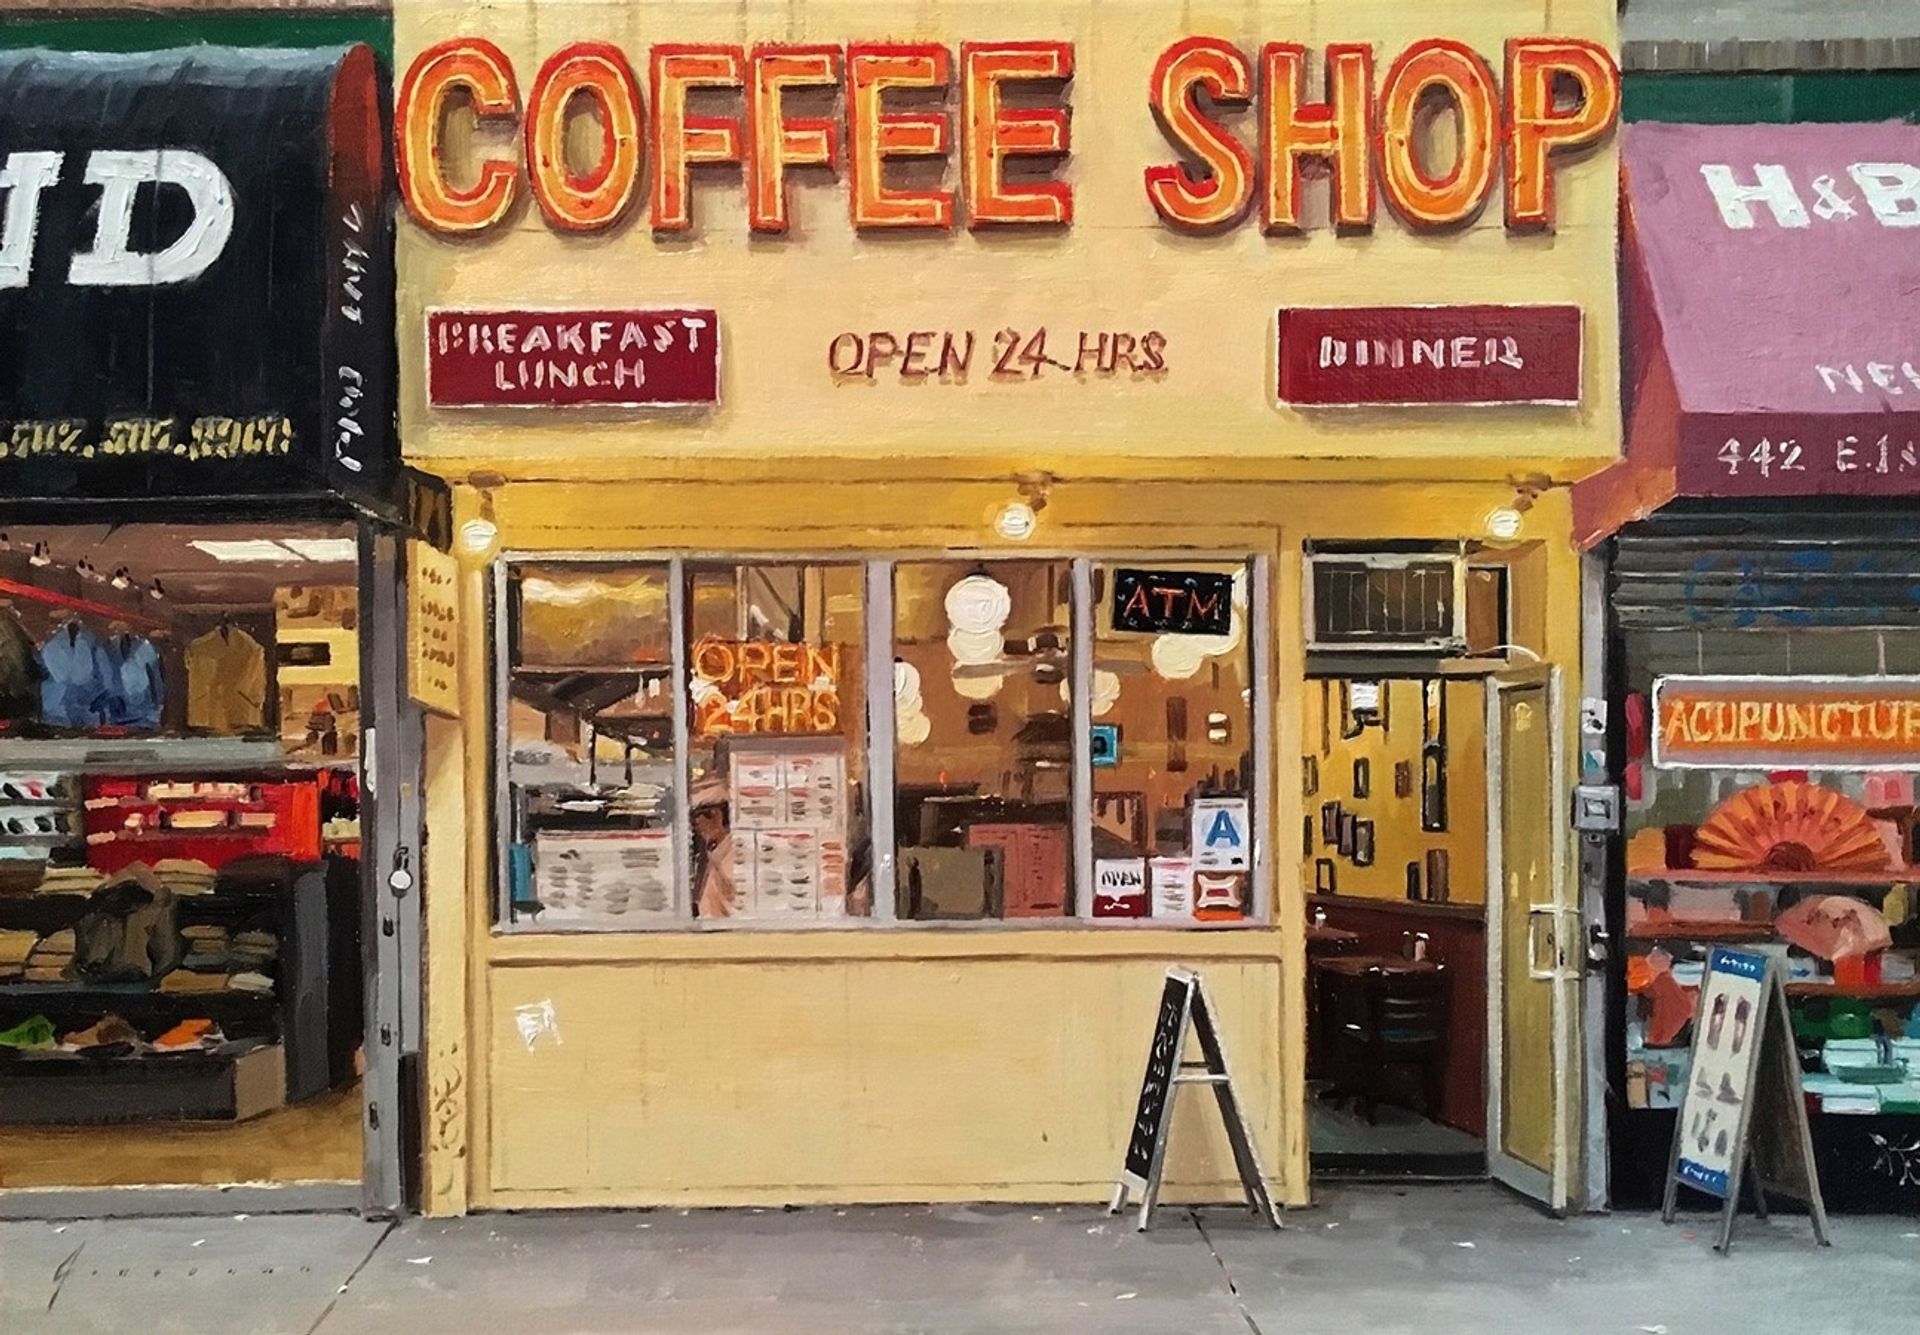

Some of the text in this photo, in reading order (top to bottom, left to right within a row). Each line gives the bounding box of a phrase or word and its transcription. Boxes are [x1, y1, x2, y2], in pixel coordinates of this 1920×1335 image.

[394, 35, 1621, 237] COFFEE SHOP
[437, 317, 708, 355] BREAKFAST
[828, 326, 1169, 380] OPEN 24 HRS
[1319, 335, 1525, 369] DINNER
[495, 357, 647, 391] LUNCH
[1716, 436, 1806, 479] 442
[1122, 584, 1220, 620] ATM
[690, 641, 841, 687] OPEN
[1204, 808, 1242, 848] A
